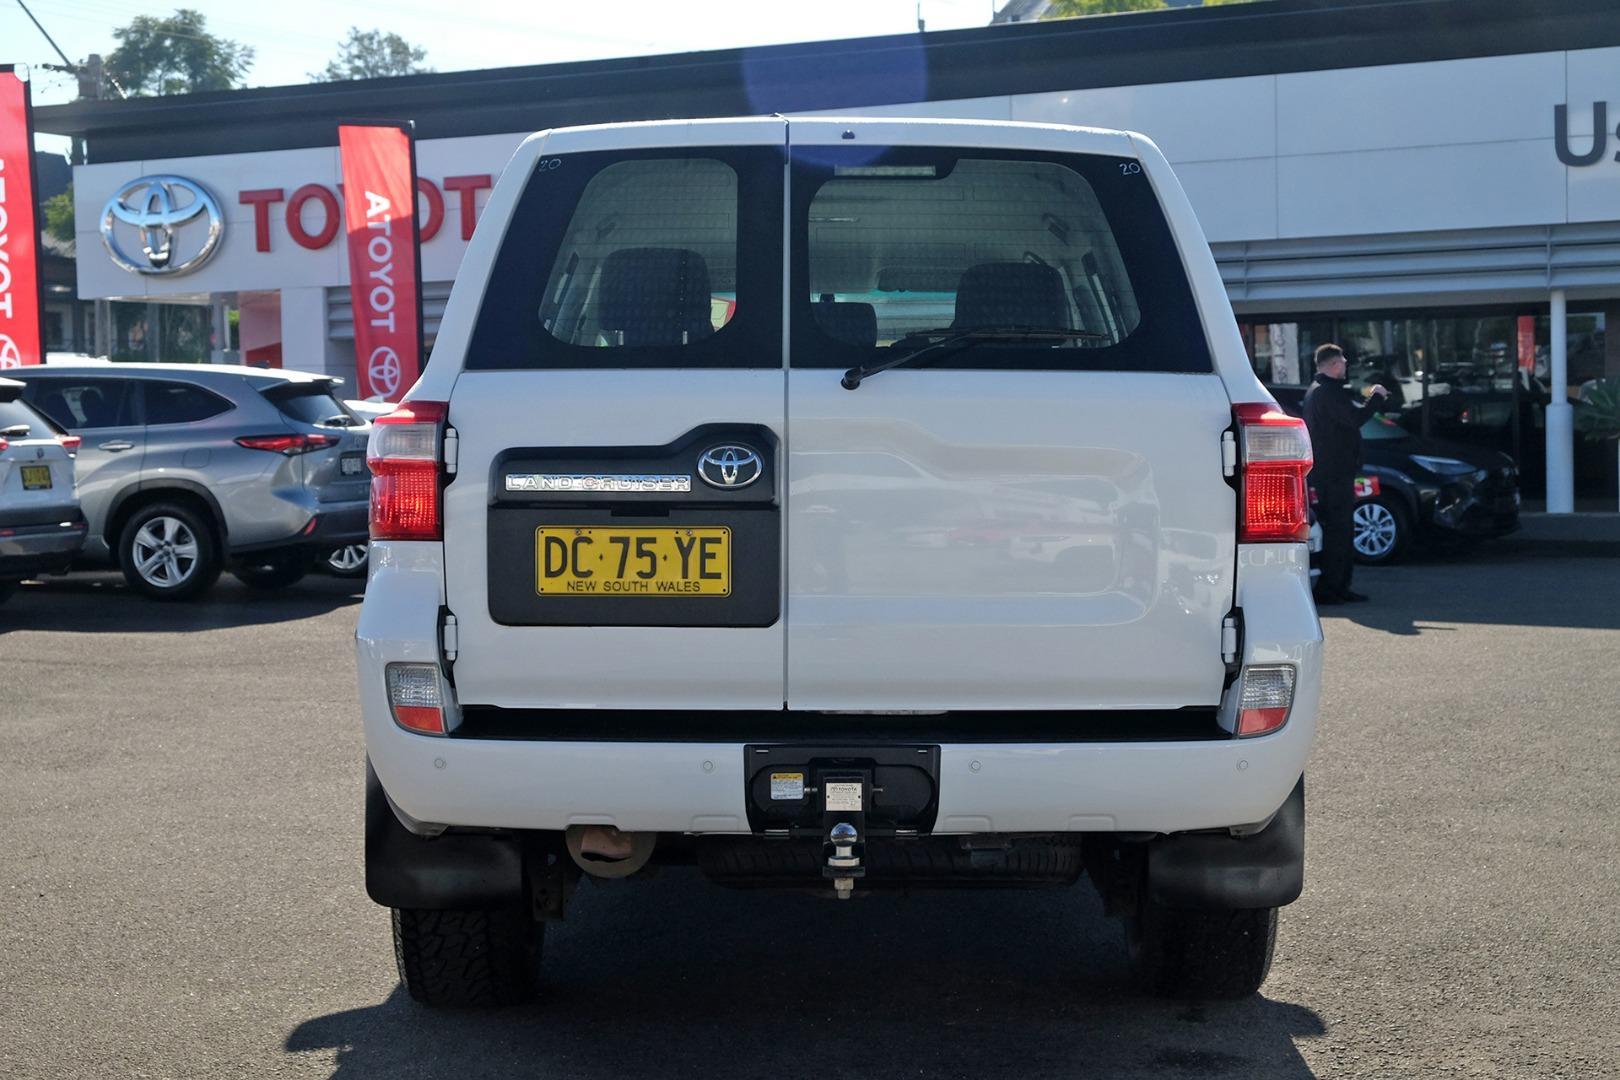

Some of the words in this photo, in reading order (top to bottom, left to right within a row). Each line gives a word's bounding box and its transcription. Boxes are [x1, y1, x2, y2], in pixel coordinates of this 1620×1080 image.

[1554, 101, 1620, 167] U
[1119, 162, 1141, 175] 20
[507, 475, 574, 490] LAND
[582, 475, 690, 490] CRUISER
[566, 580, 597, 592] NEW
[603, 580, 648, 592] SOUTH
[656, 580, 700, 592] WALES
